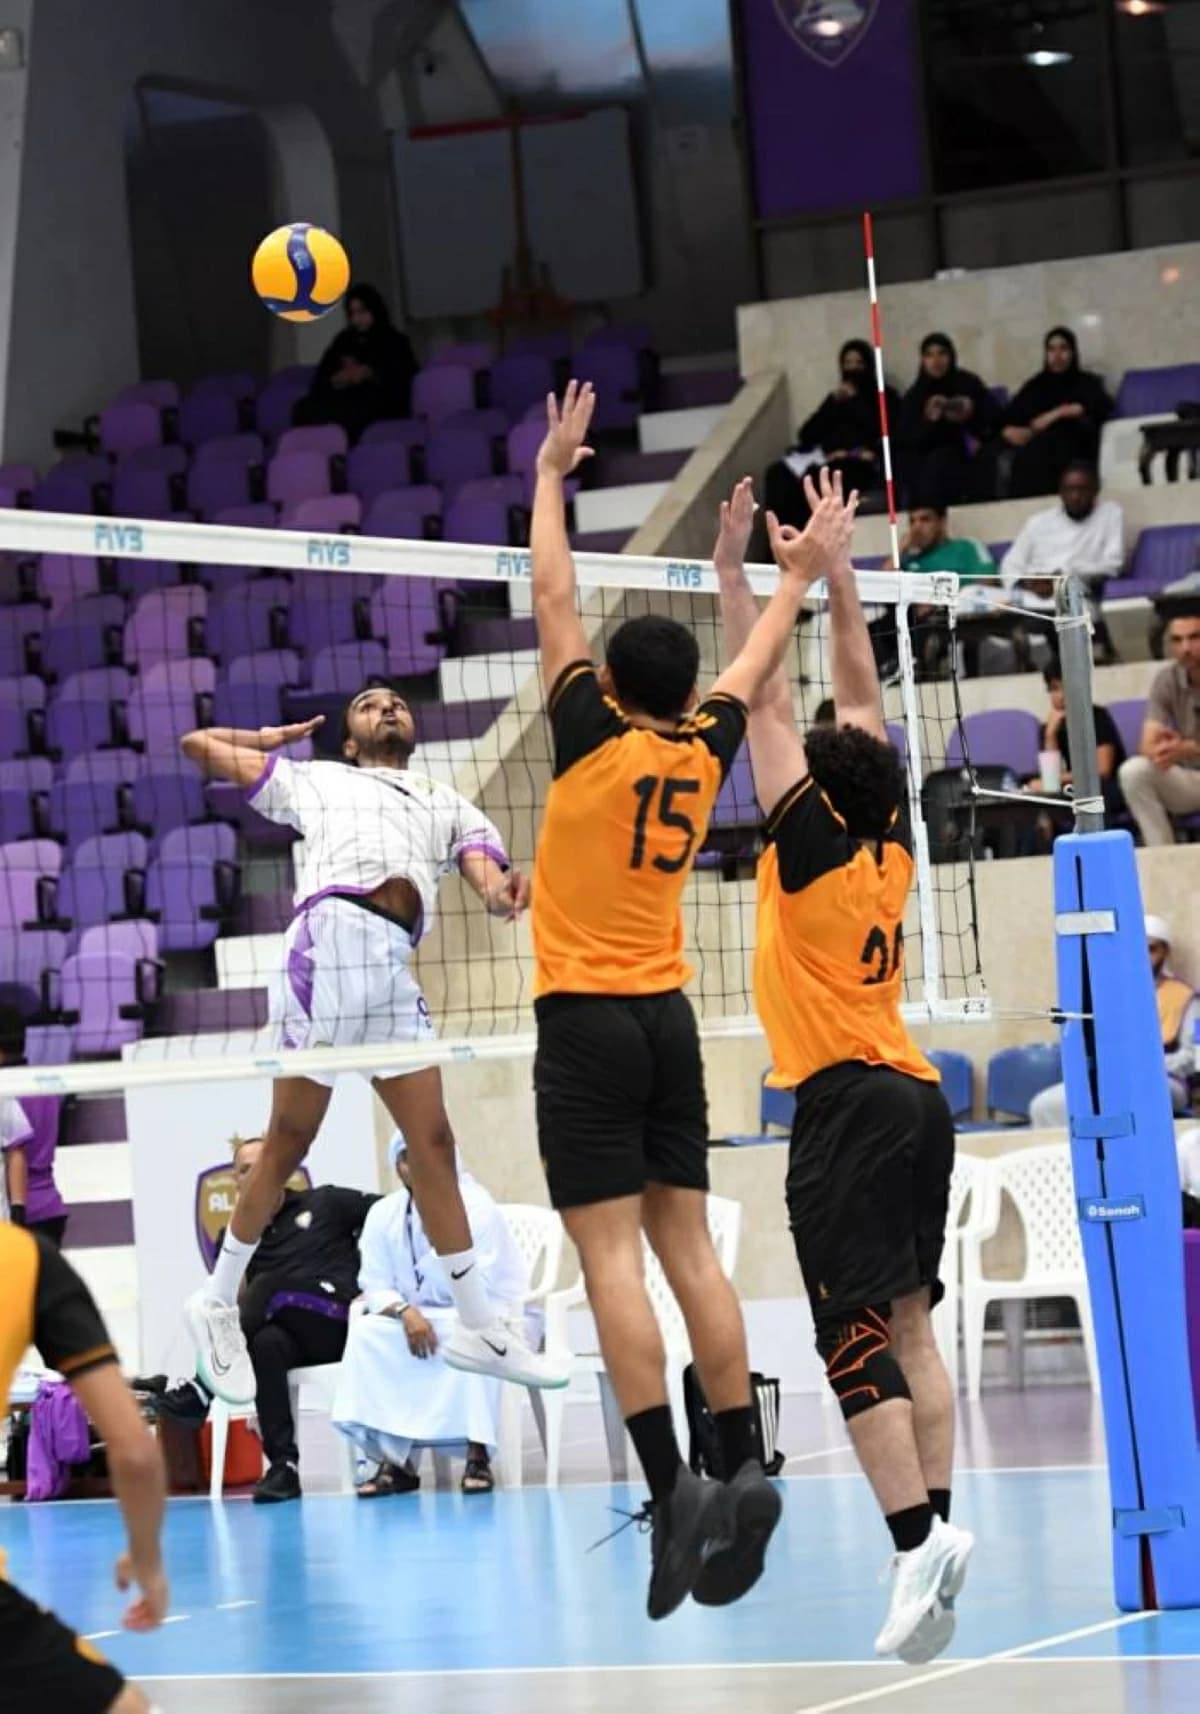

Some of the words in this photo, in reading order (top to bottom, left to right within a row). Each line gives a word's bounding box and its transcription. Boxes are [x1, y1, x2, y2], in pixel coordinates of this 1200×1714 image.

[94, 524, 143, 551] FIVB
[306, 540, 350, 564] FIVB
[665, 563, 702, 587] FIVB
[630, 776, 699, 872] 15
